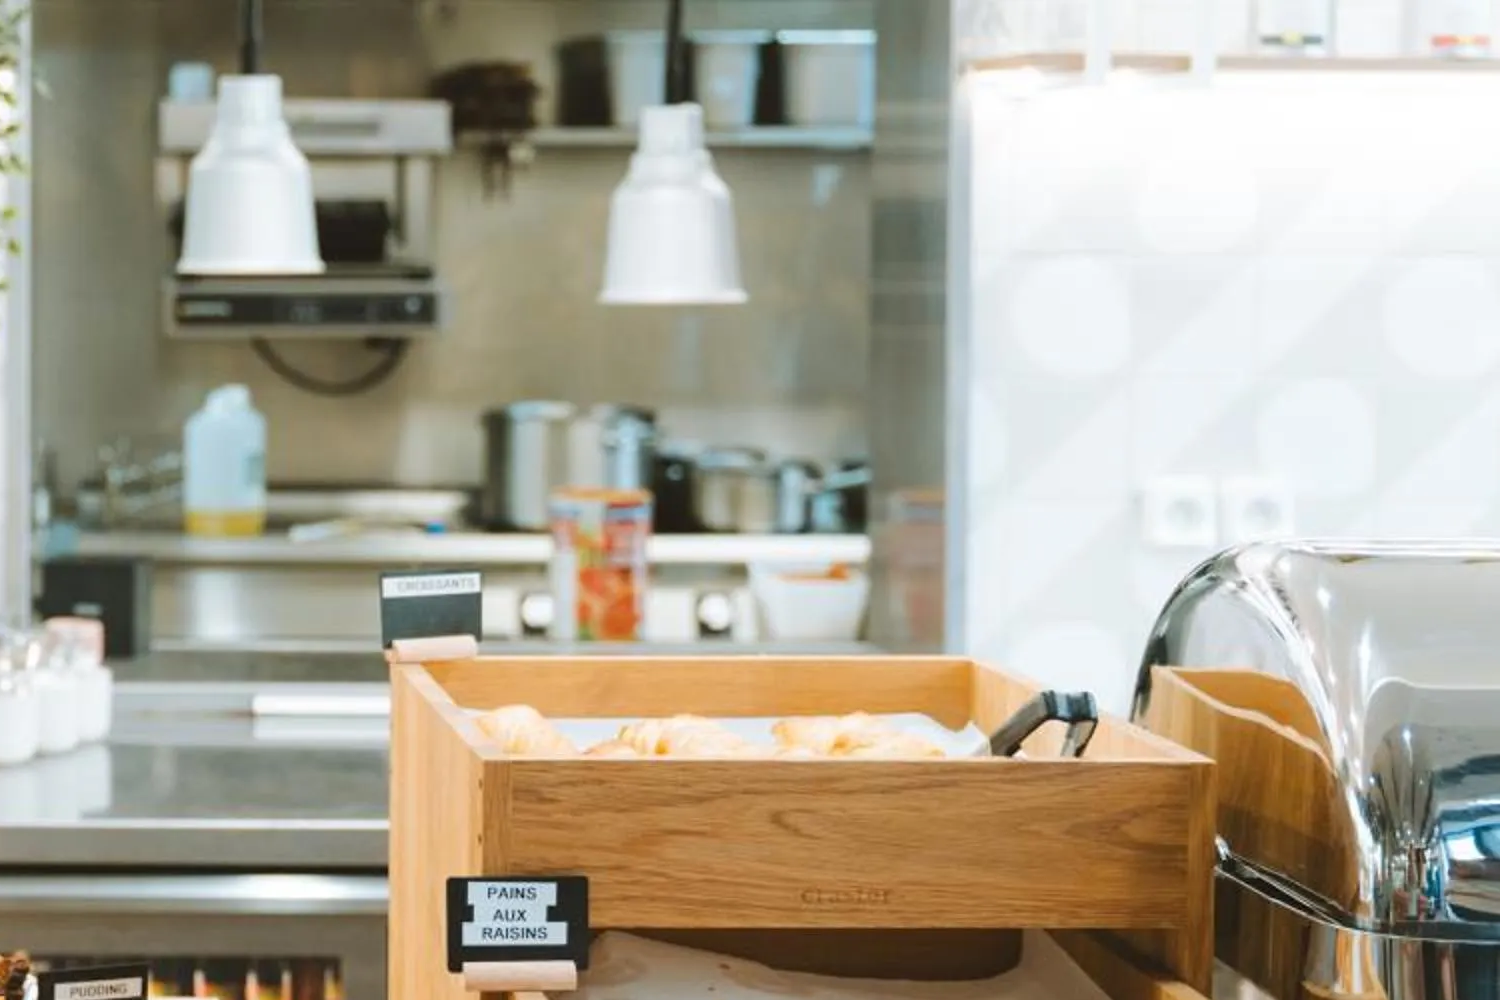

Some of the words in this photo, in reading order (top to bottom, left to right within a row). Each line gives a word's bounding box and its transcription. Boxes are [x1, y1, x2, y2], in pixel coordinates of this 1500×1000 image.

[486, 886, 538, 901] PAINS
[492, 908, 528, 922] AUX
[481, 926, 548, 941] RAISINS
[69, 982, 129, 999] PUDDING
